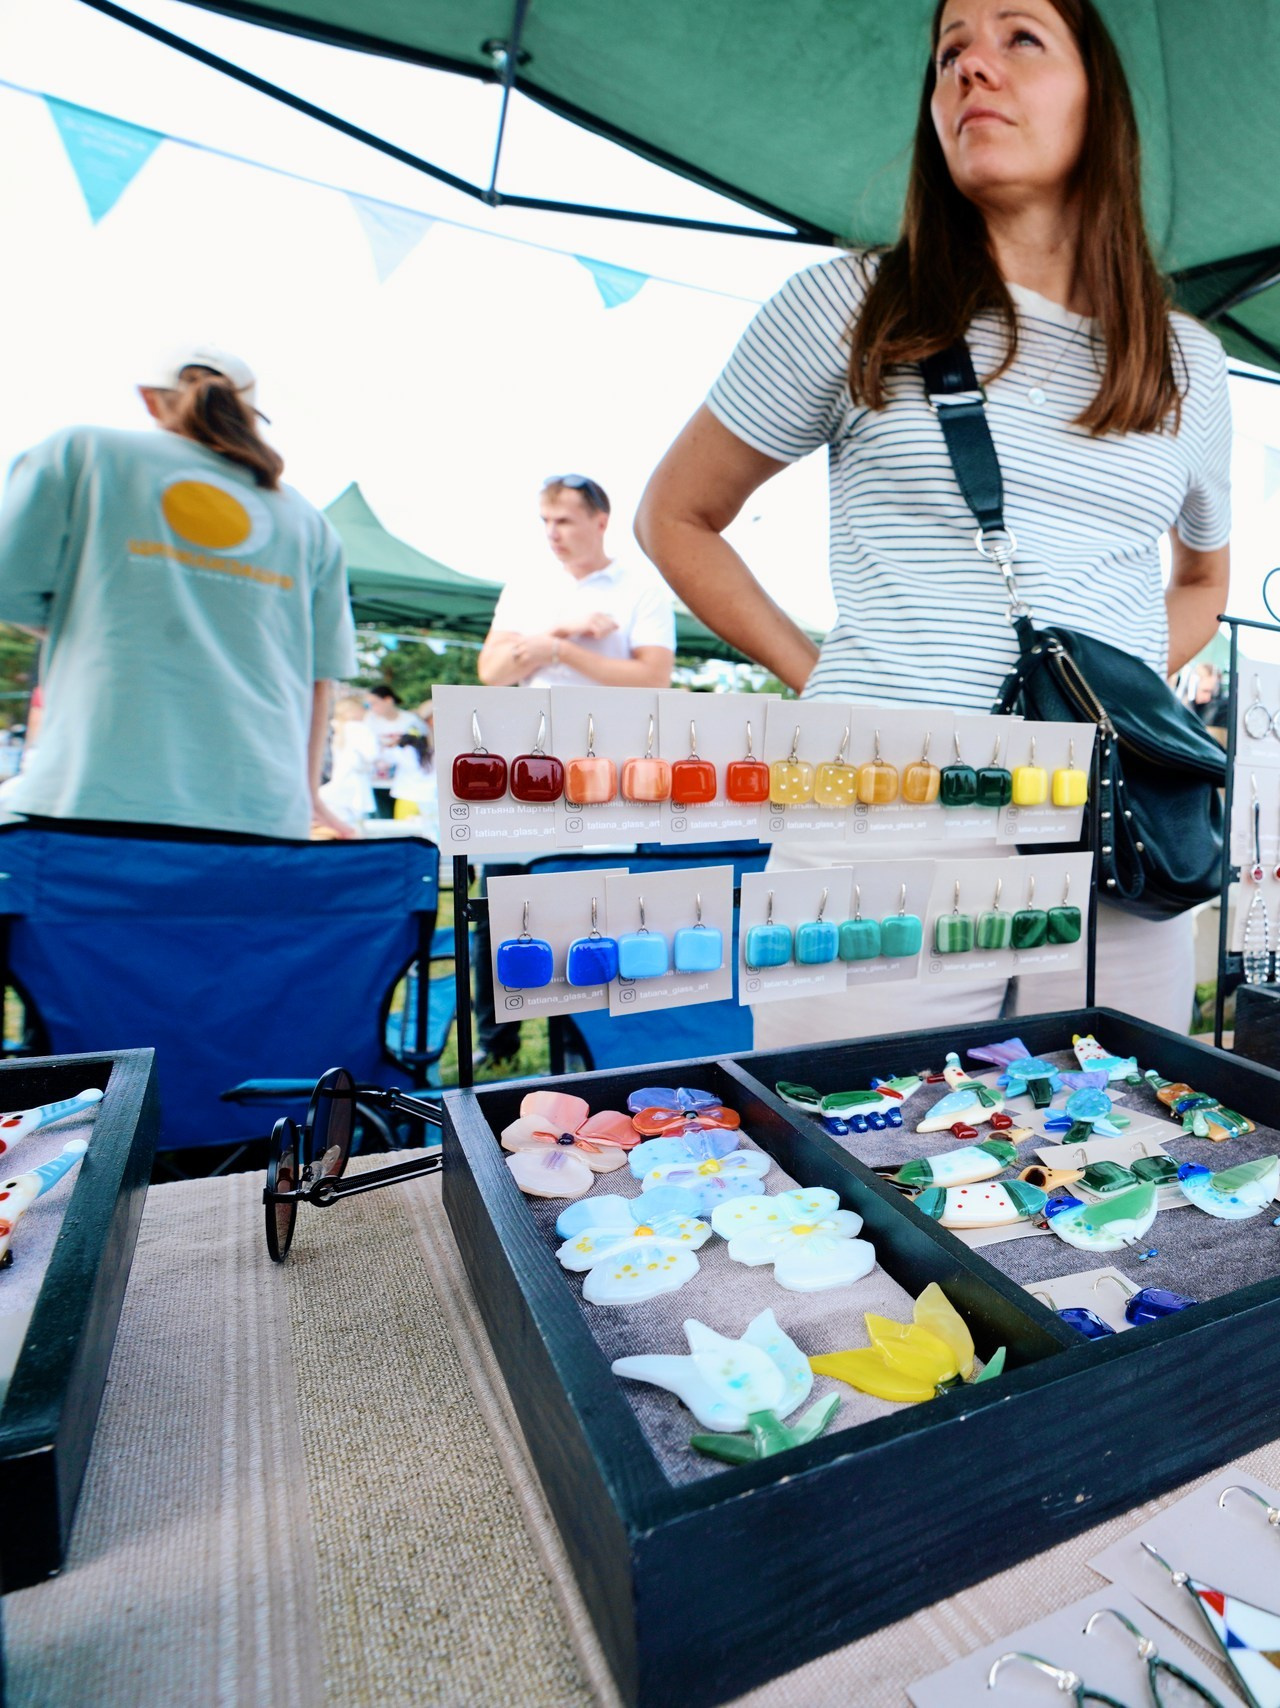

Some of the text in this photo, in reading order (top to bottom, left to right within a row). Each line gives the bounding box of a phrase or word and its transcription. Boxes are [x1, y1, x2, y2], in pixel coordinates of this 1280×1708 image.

[474, 805, 516, 817] Татьяна
[586, 818, 661, 831] tatiana_glass_art
[690, 817, 757, 830] tatiana_glass_art
[786, 819, 846, 830] tatiana_glass_ar
[869, 821, 927, 832] tatiana_glass_art
[474, 826, 556, 839] tatiana_glass_art
[763, 974, 826, 989] tatiana_glass_art
[639, 982, 710, 999] tatiana_glass_art
[527, 988, 605, 1007] tatiana_glass_art
